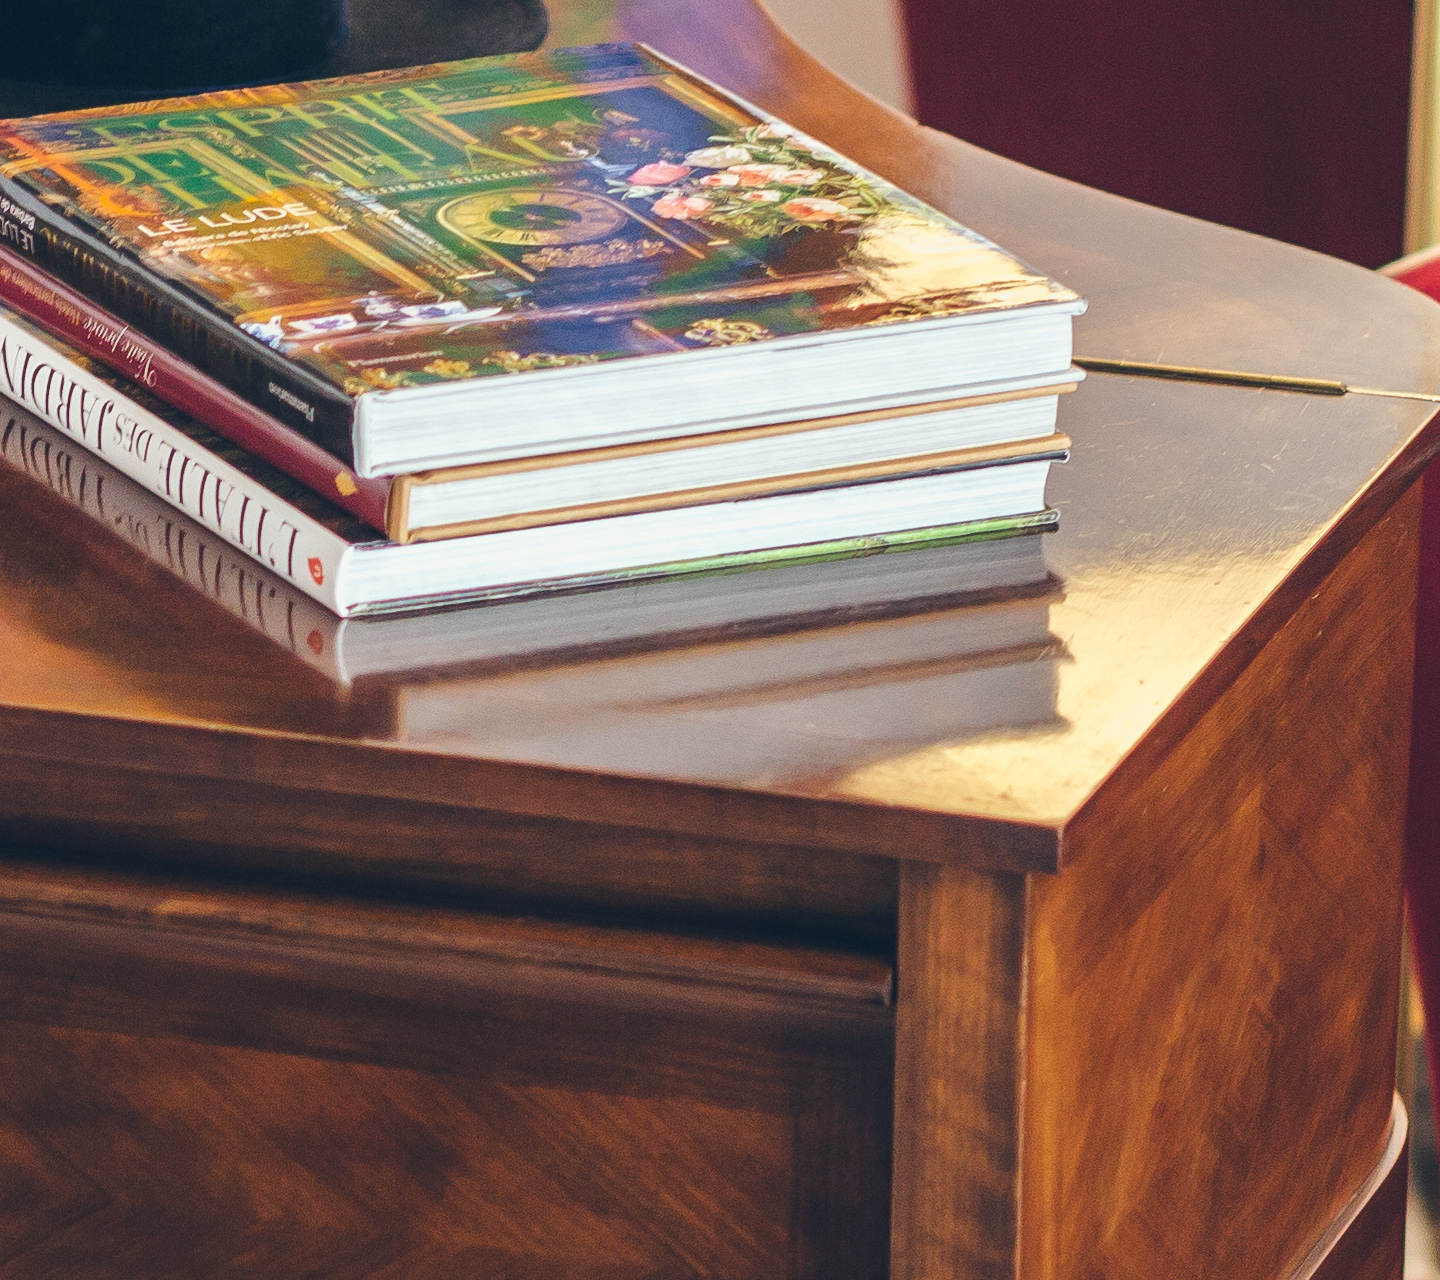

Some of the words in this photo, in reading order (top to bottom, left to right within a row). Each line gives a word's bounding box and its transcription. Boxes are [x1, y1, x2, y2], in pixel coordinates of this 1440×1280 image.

[138, 219, 197, 237] LE
[198, 202, 318, 228] LUDE
[20, 229, 35, 255] LE
[82, 316, 129, 354] privée
[120, 338, 158, 388] Visite
[113, 412, 154, 463] DES
[157, 440, 301, 578] L'ITALIE
